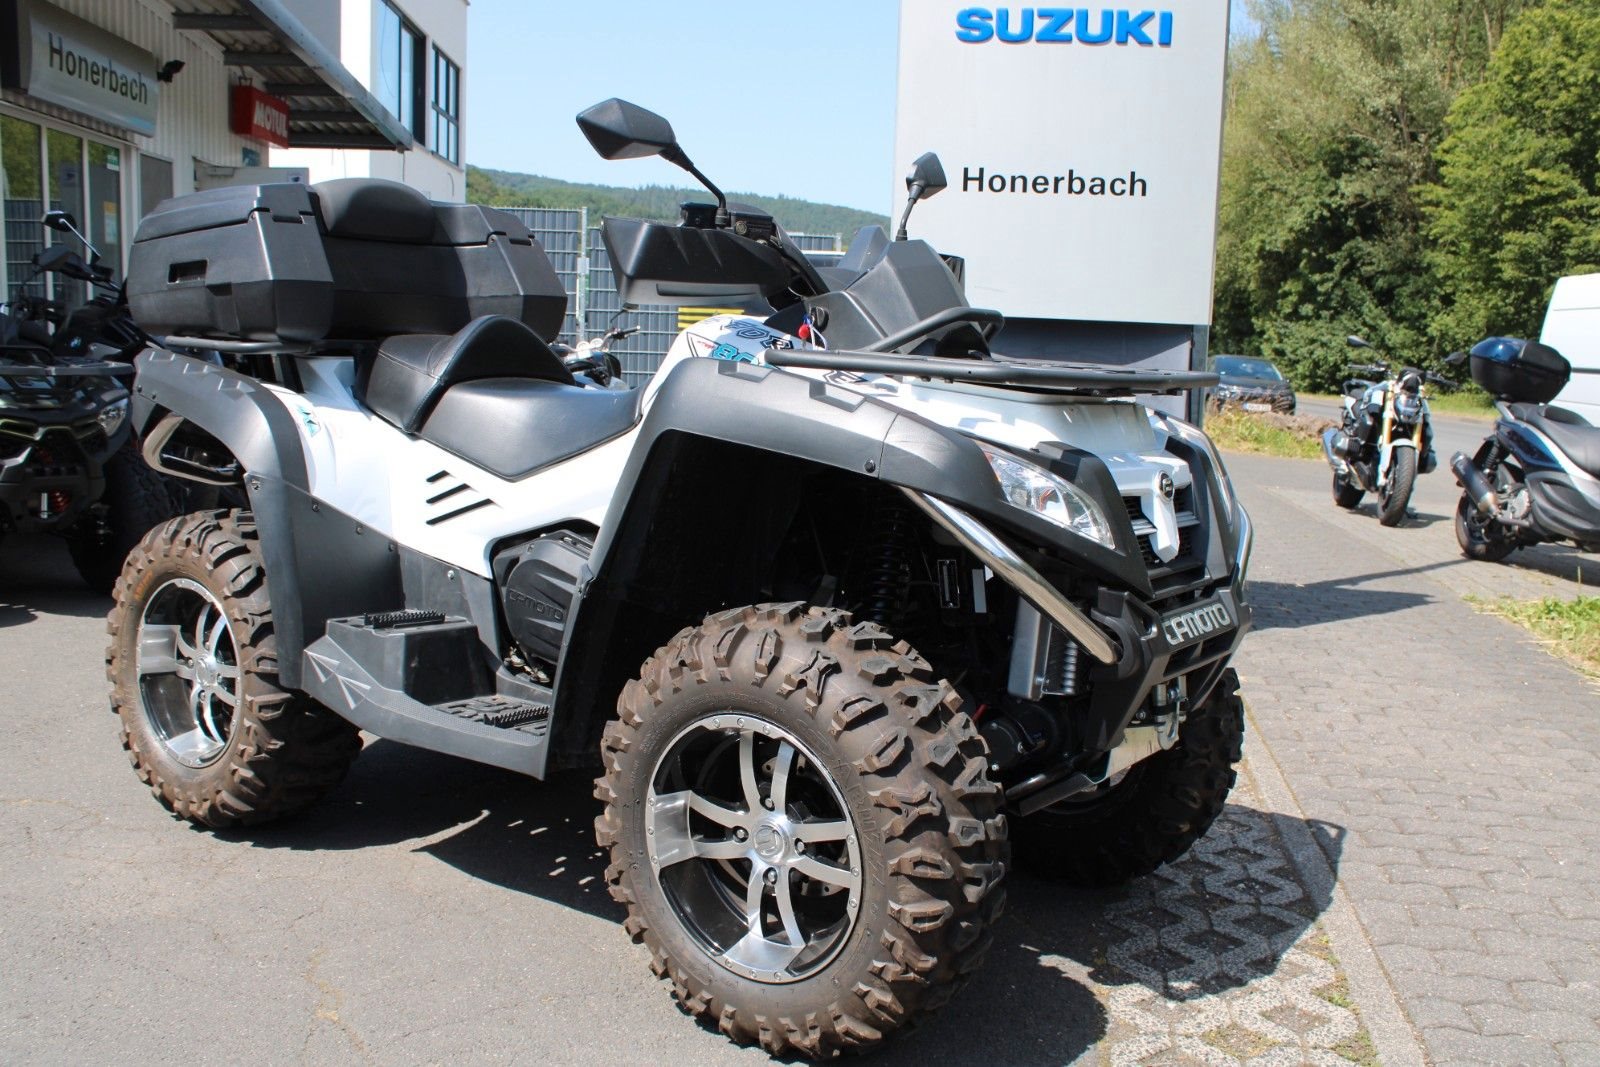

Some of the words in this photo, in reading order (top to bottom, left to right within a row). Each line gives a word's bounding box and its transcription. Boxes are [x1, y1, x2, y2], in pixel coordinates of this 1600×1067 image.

[955, 7, 1173, 47] SUZUKI
[48, 32, 148, 105] Honerbach
[253, 100, 288, 138] MOTUL
[961, 167, 1148, 197] Honerbach
[1161, 602, 1231, 645] CFMOTO
